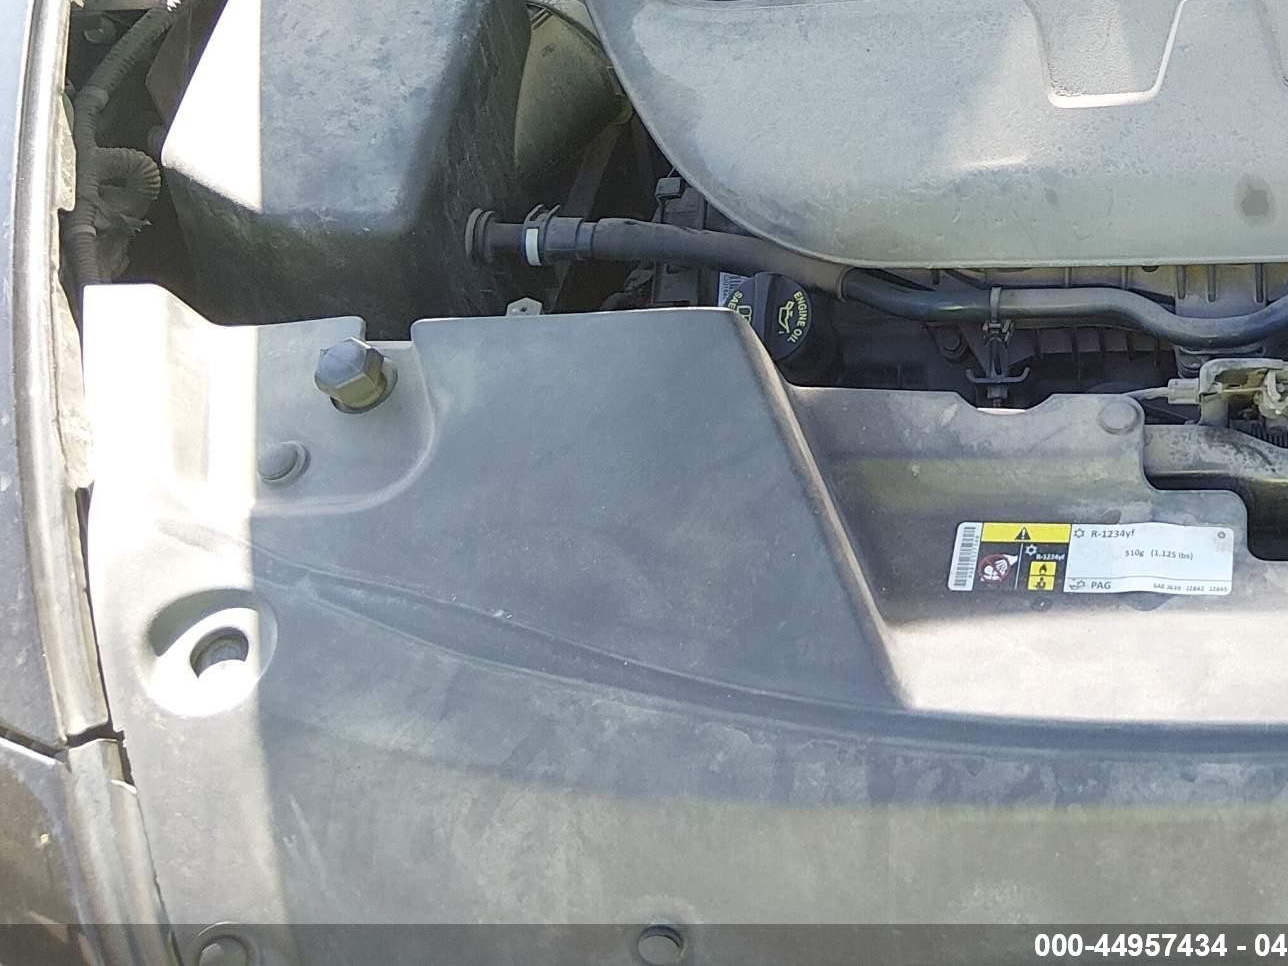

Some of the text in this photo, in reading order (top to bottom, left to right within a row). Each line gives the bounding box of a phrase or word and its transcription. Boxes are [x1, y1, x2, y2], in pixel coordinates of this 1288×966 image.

[728, 291, 743, 309] SAE
[787, 291, 807, 343] ENGINE OIL
[1090, 528, 1135, 540] R-1234yf
[1125, 549, 1194, 561] 510g (1.125 lbs)
[1090, 581, 1111, 590] PAG
